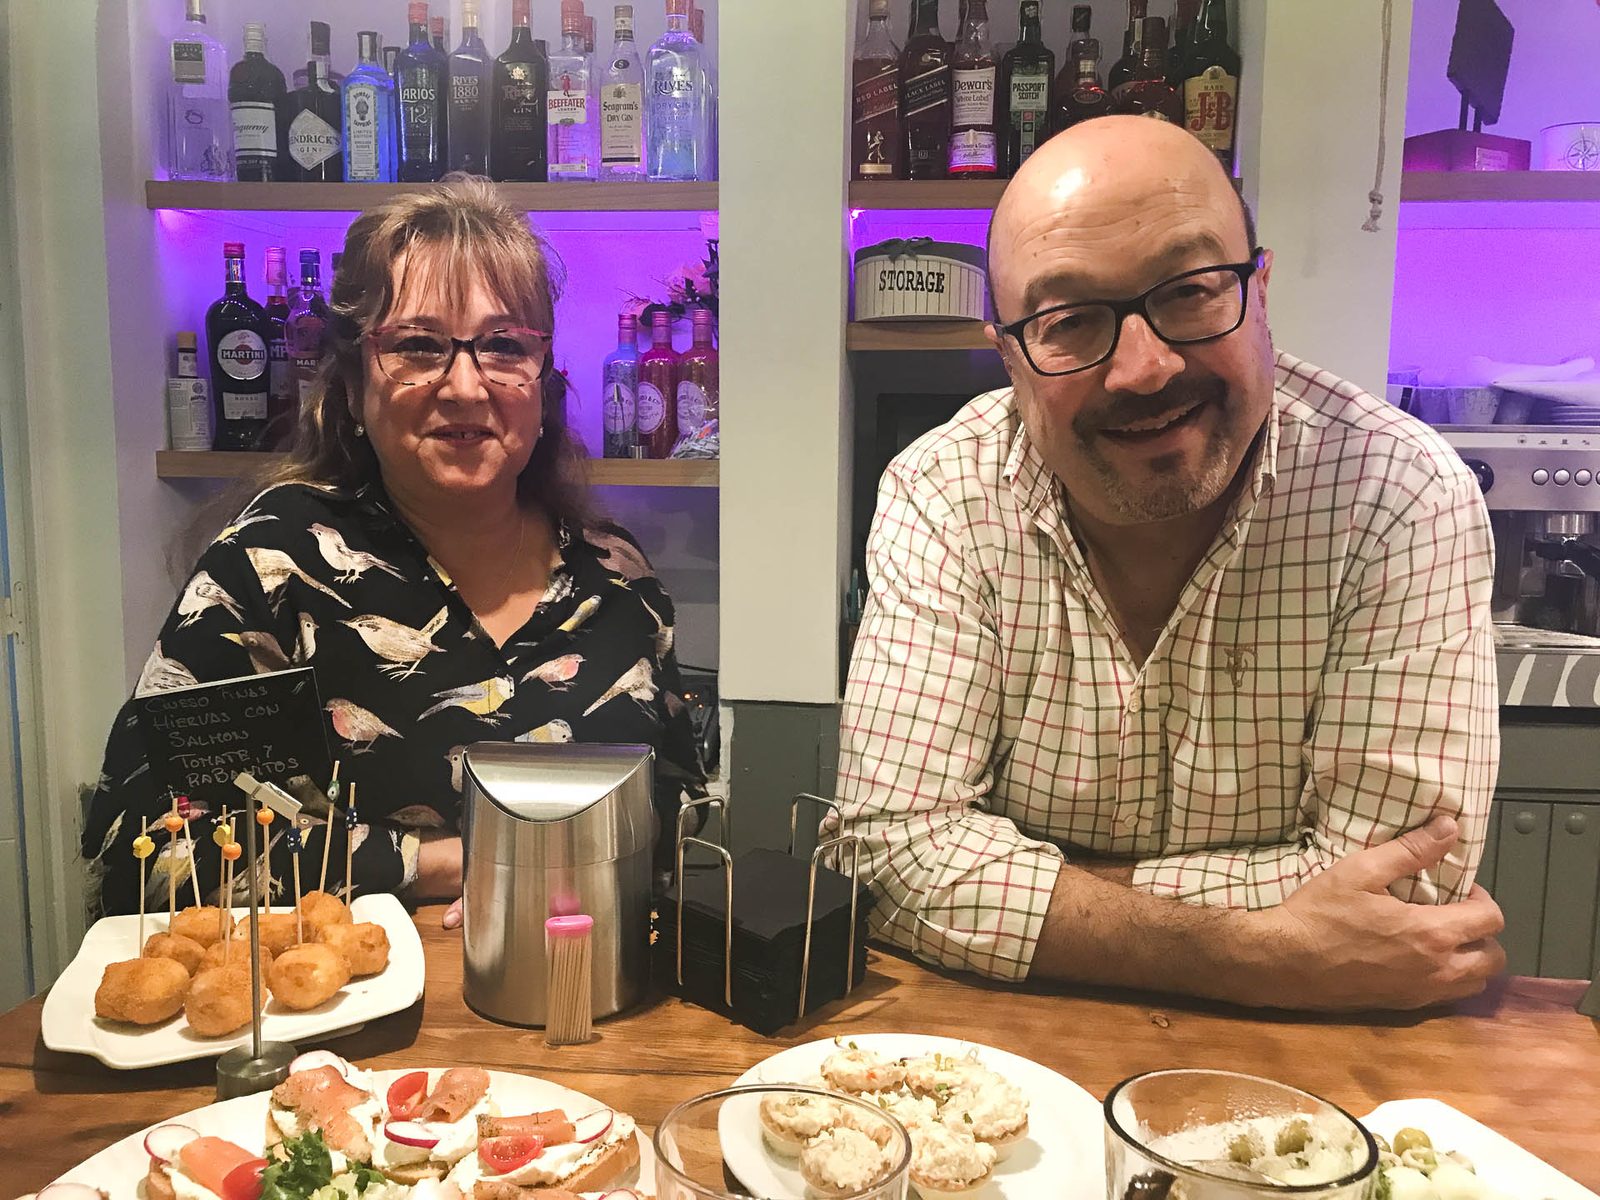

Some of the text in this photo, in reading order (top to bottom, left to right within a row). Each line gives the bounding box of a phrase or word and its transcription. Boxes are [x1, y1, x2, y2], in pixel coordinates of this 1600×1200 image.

[452, 75, 479, 86] RIVES
[925, 79, 946, 91] LABEL
[954, 80, 993, 92] Dewar's
[453, 86, 479, 99] 1880
[654, 80, 693, 95] RIVES
[873, 82, 899, 96] LABEL
[1012, 82, 1046, 92] PASSPORT
[402, 88, 436, 100] ARIOS
[1018, 92, 1040, 100] SCOTCH
[548, 98, 586, 110] BEEFEATER
[602, 101, 639, 113] Seagram's
[410, 105, 428, 123] 12
[1190, 91, 1232, 131] J&B
[606, 113, 634, 123] DRY GIN
[290, 134, 341, 146] ENDRICK'S
[879, 270, 945, 293] STORAGE
[222, 350, 264, 360] MARTINI
[245, 704, 279, 718] CON
[169, 730, 249, 748] SALMON
